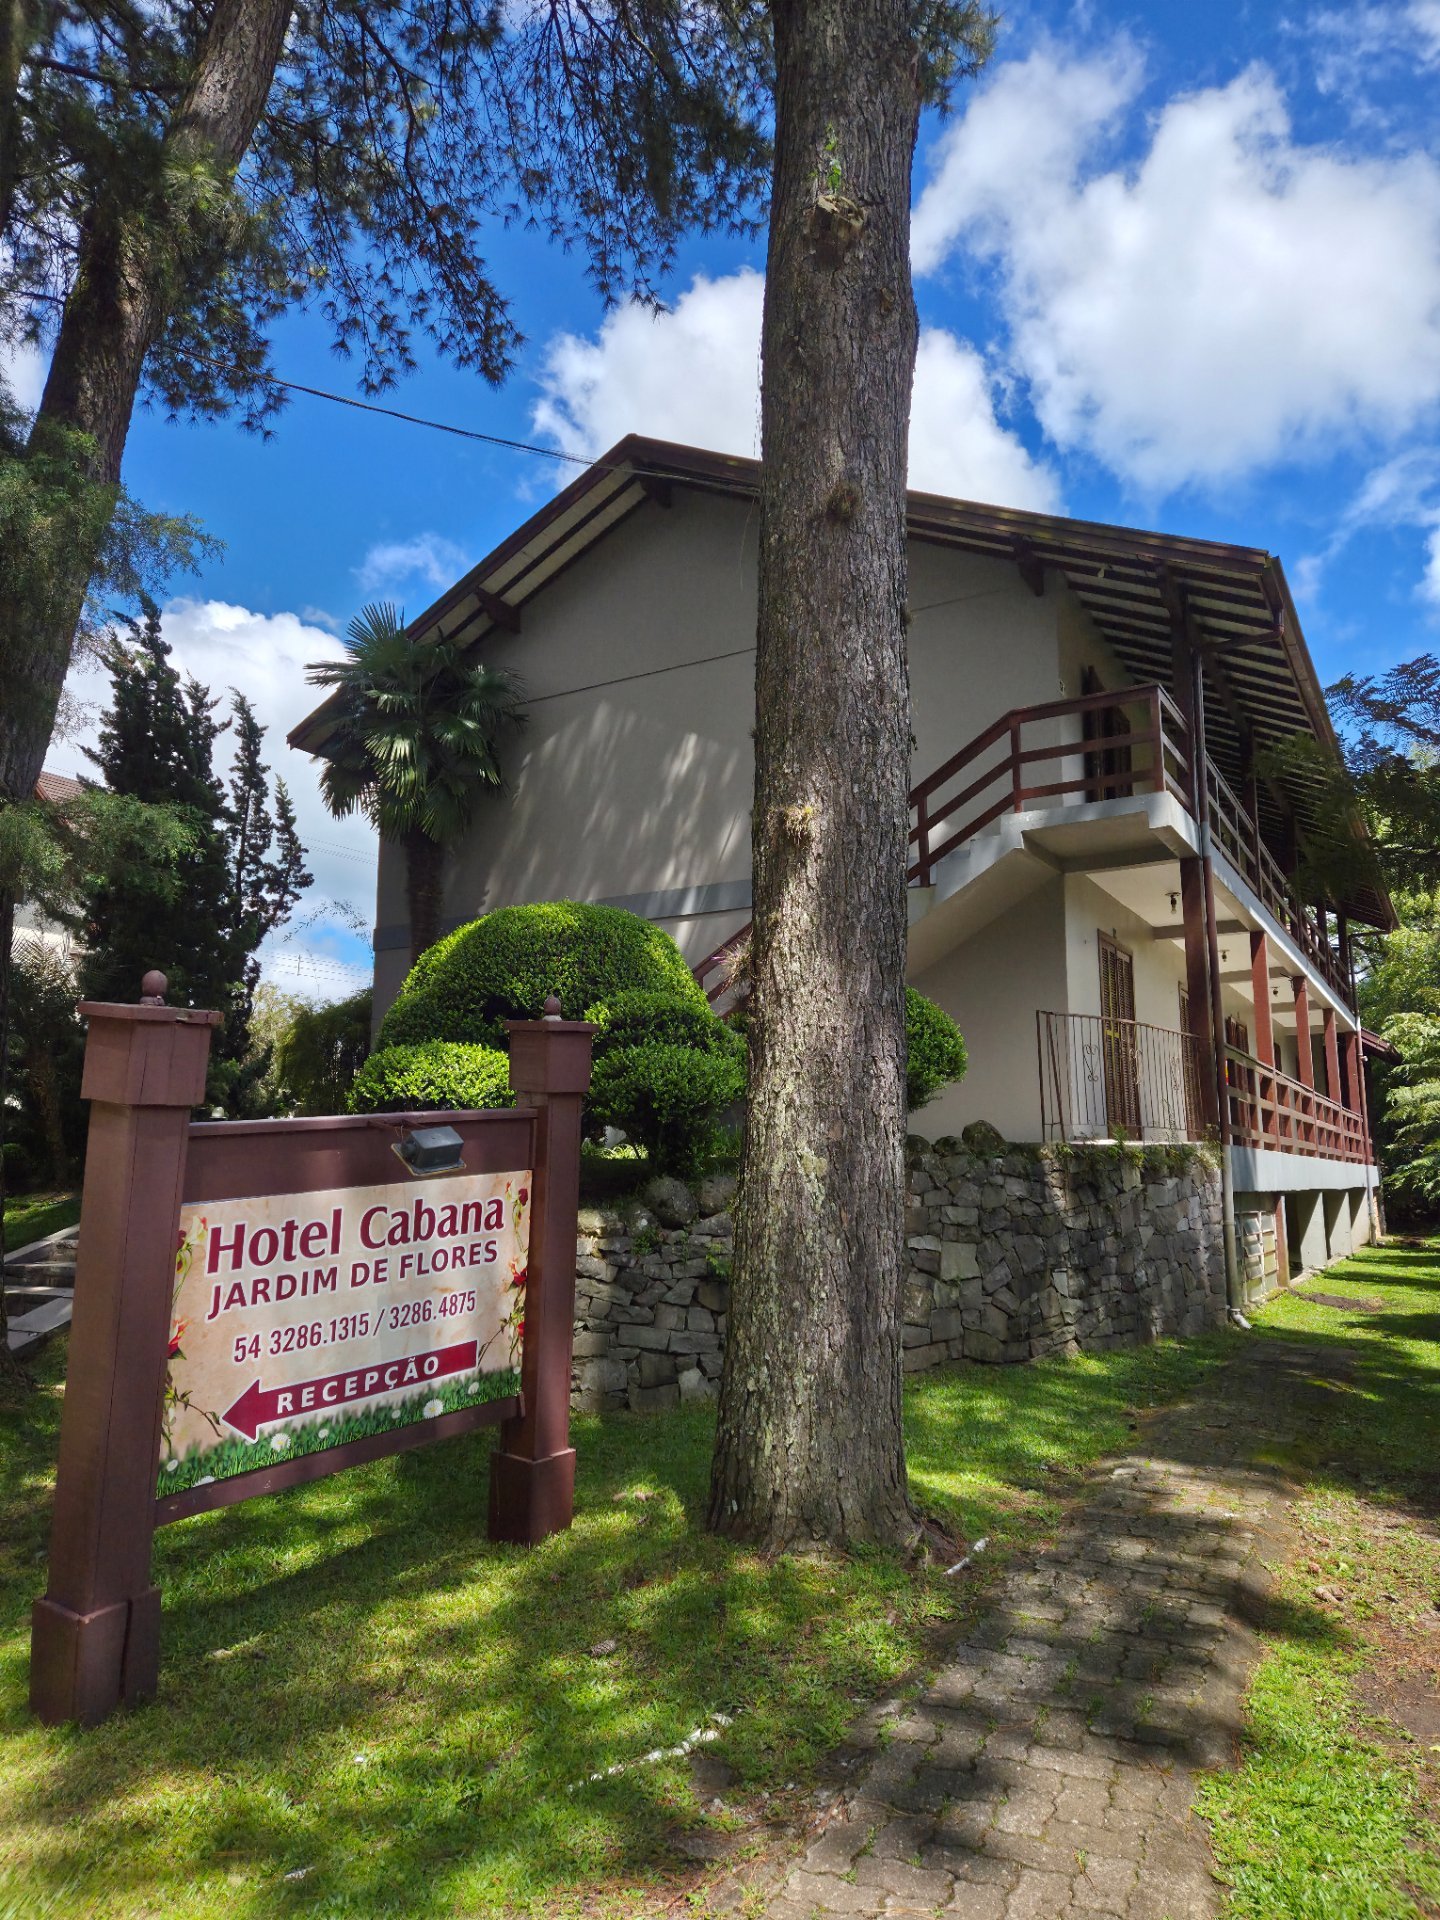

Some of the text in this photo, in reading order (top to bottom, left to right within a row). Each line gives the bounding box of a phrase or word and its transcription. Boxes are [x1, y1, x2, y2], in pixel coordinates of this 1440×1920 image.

[207, 1197, 504, 1273] Hotel Cabana
[207, 1240, 498, 1320] JARDIM DE FLORES
[234, 1334, 261, 1362] 54
[276, 1355, 439, 1414] RECEPÇÃO
